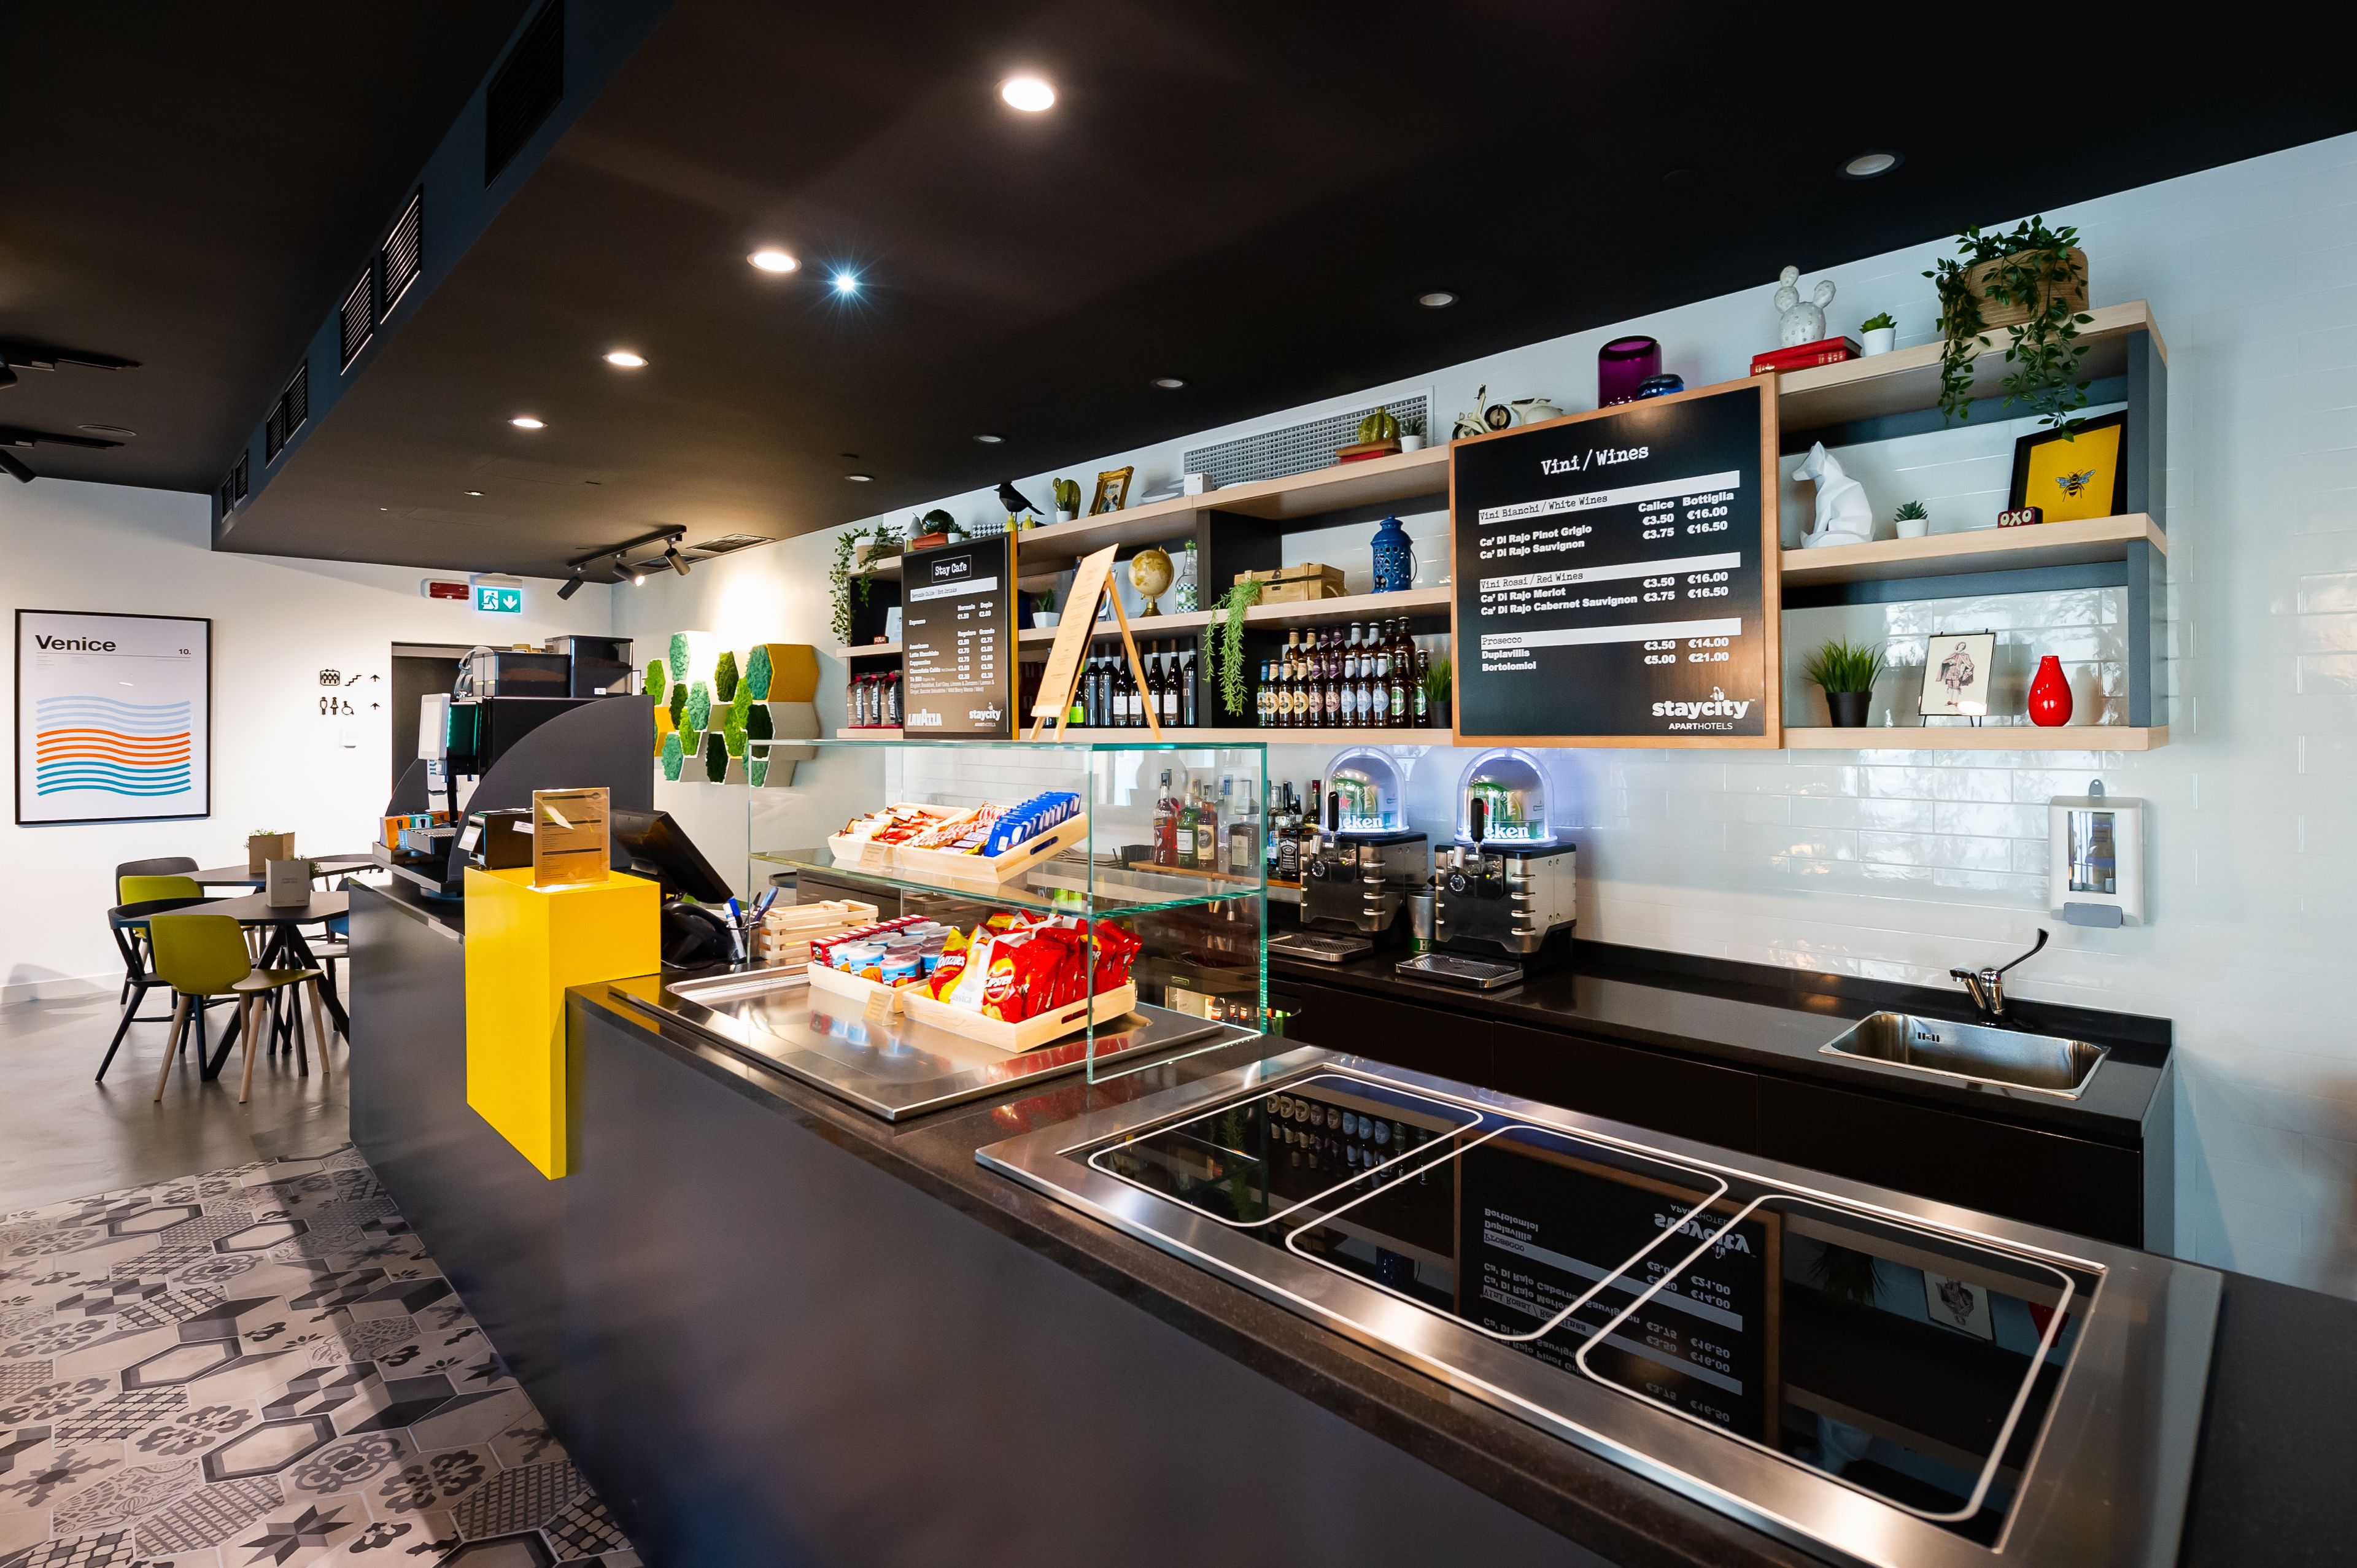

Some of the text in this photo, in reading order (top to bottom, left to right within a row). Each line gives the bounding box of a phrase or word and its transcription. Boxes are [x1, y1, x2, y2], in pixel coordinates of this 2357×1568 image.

[1541, 455, 1581, 475] Vini
[1596, 446, 1649, 466] Wines
[1480, 510, 1500, 520] Vini
[1502, 504, 1540, 518] Bianchi
[1549, 498, 1576, 511] White
[1579, 495, 1608, 506] Wines
[1638, 491, 1735, 513] Calice Bottiglia
[1642, 506, 1728, 526] €3.50 €16.00
[2000, 509, 2032, 526] OXO
[1509, 533, 1531, 545] Rajo
[1533, 529, 1559, 541] Pinot
[1560, 525, 1592, 536] Grigio
[1643, 520, 1728, 540] €3.75 €16.50
[1509, 546, 1531, 557] Rajo
[1533, 540, 1585, 552] Sauvignon
[935, 562, 967, 576] Stay Cafe
[1503, 577, 1528, 587] Rossi
[1536, 574, 1552, 584] Red
[1555, 571, 1584, 581] Wines
[1643, 571, 1729, 589] €3.50 €16.00
[1509, 591, 1531, 601] Rajo
[1533, 587, 1566, 598] Merlot
[1643, 586, 1729, 603] €3.75 €16.50
[1509, 603, 1532, 614] Rajo
[1534, 598, 1581, 611] Cabernet
[1582, 595, 1638, 608] Sauvignon
[35, 635, 117, 652] Venice
[1481, 636, 1522, 646] Prosecco
[1644, 637, 1729, 651] €3.50 €14.00
[1482, 649, 1530, 660] Duplavillis
[1644, 652, 1730, 665] €5.00 €21.00
[1482, 661, 1537, 671] Bortolomiol
[1652, 700, 1749, 720] staycity
